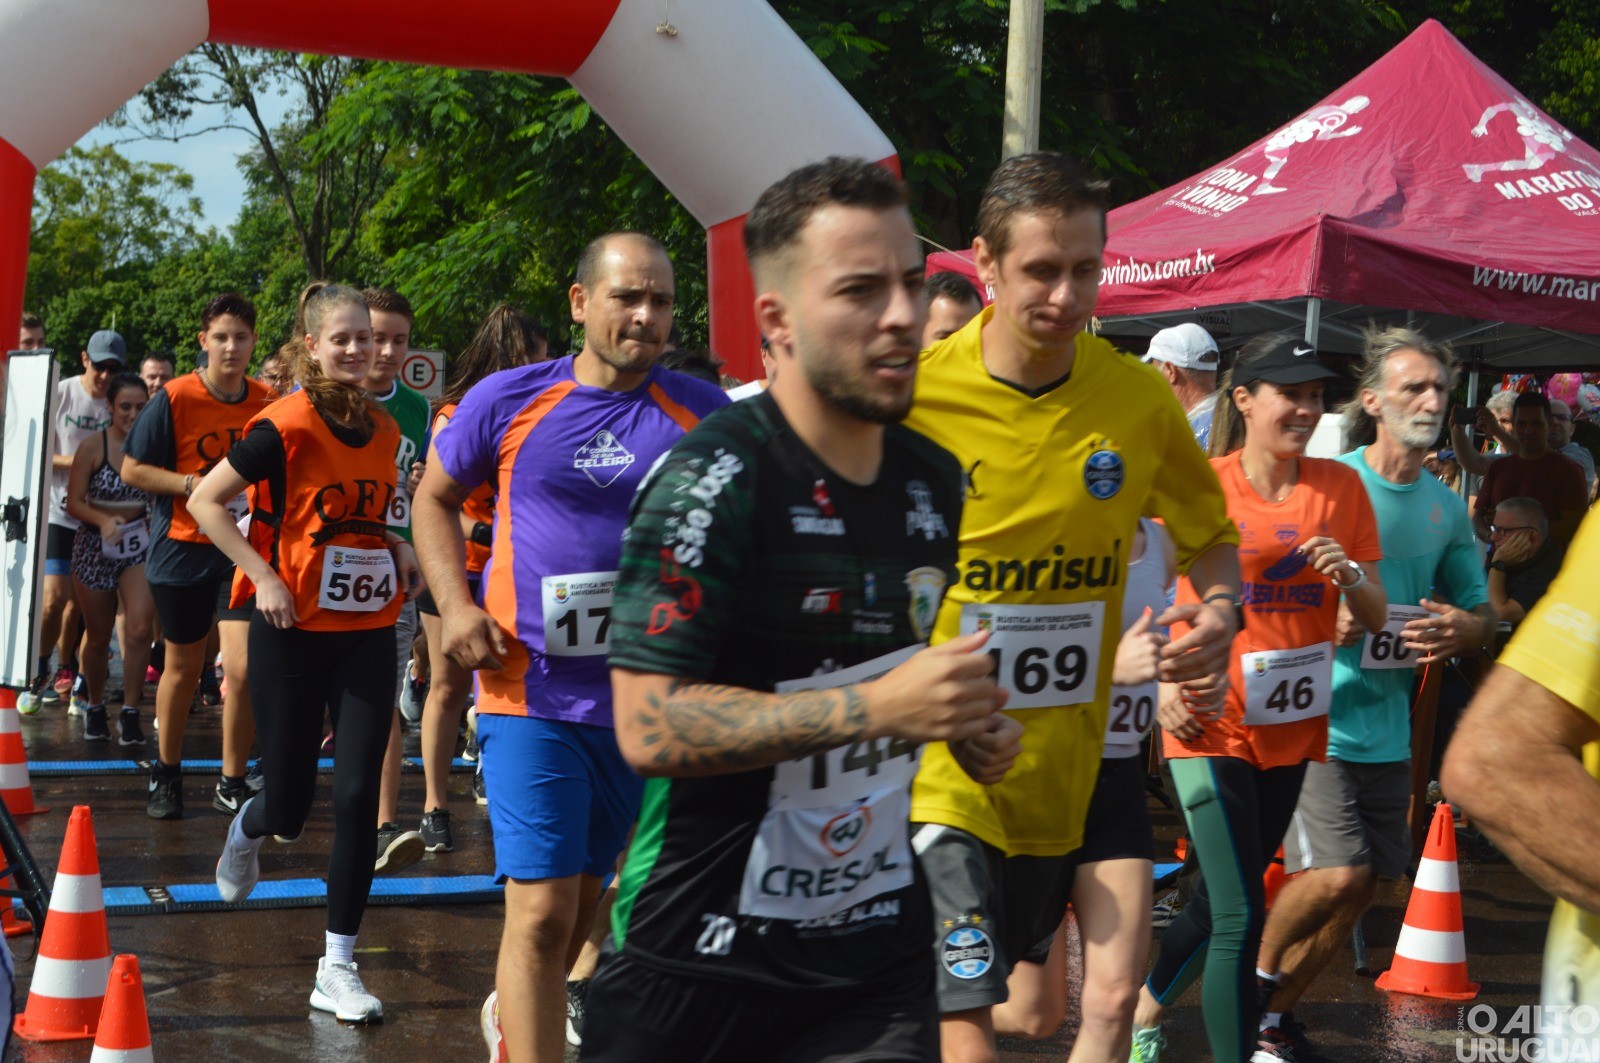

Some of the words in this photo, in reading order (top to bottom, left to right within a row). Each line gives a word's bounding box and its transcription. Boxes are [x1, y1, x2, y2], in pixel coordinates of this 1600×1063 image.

[1181, 185, 1250, 213] VINHO
[1557, 192, 1594, 211] DO
[412, 363, 425, 382] E
[574, 453, 636, 469] CELEIRO
[326, 571, 392, 604] 564
[1265, 676, 1315, 715] 46
[1110, 694, 1154, 734] 20
